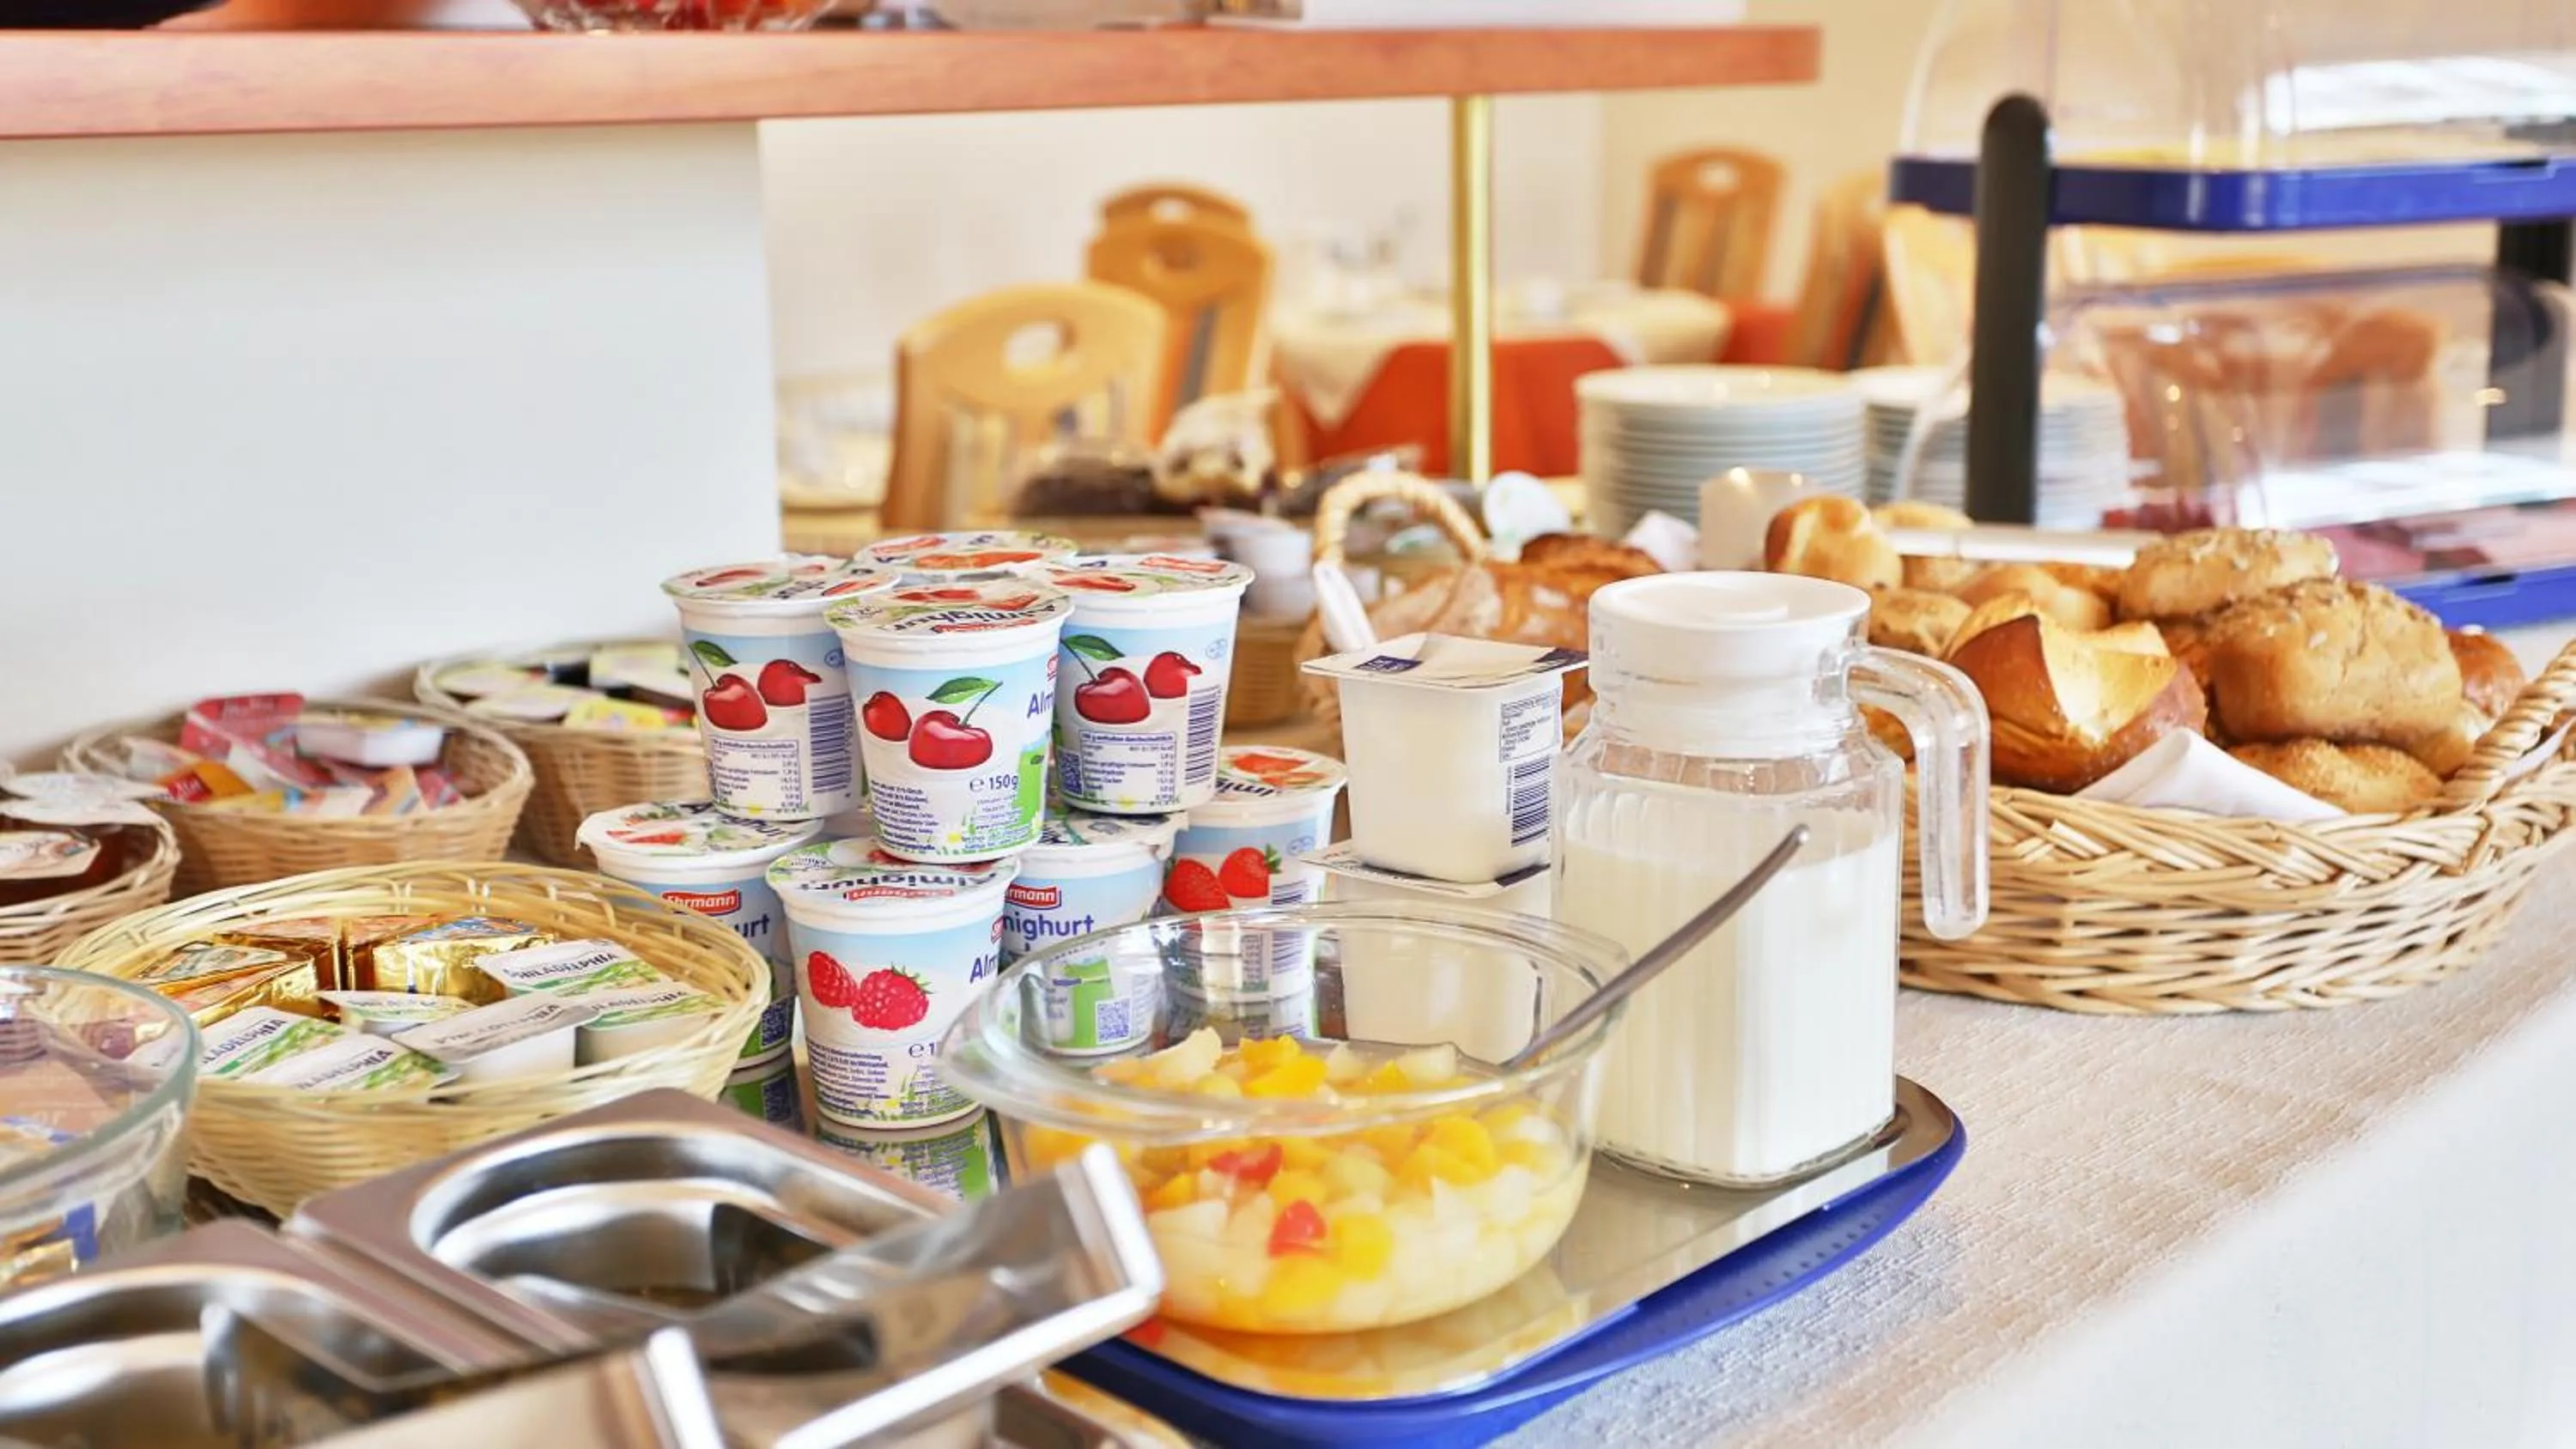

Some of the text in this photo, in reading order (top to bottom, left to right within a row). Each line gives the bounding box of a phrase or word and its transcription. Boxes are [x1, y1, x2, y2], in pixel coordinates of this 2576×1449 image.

[989, 774, 1019, 791] 150g
[1008, 888, 1055, 901] rmann
[1003, 911, 1095, 941] mighurt
